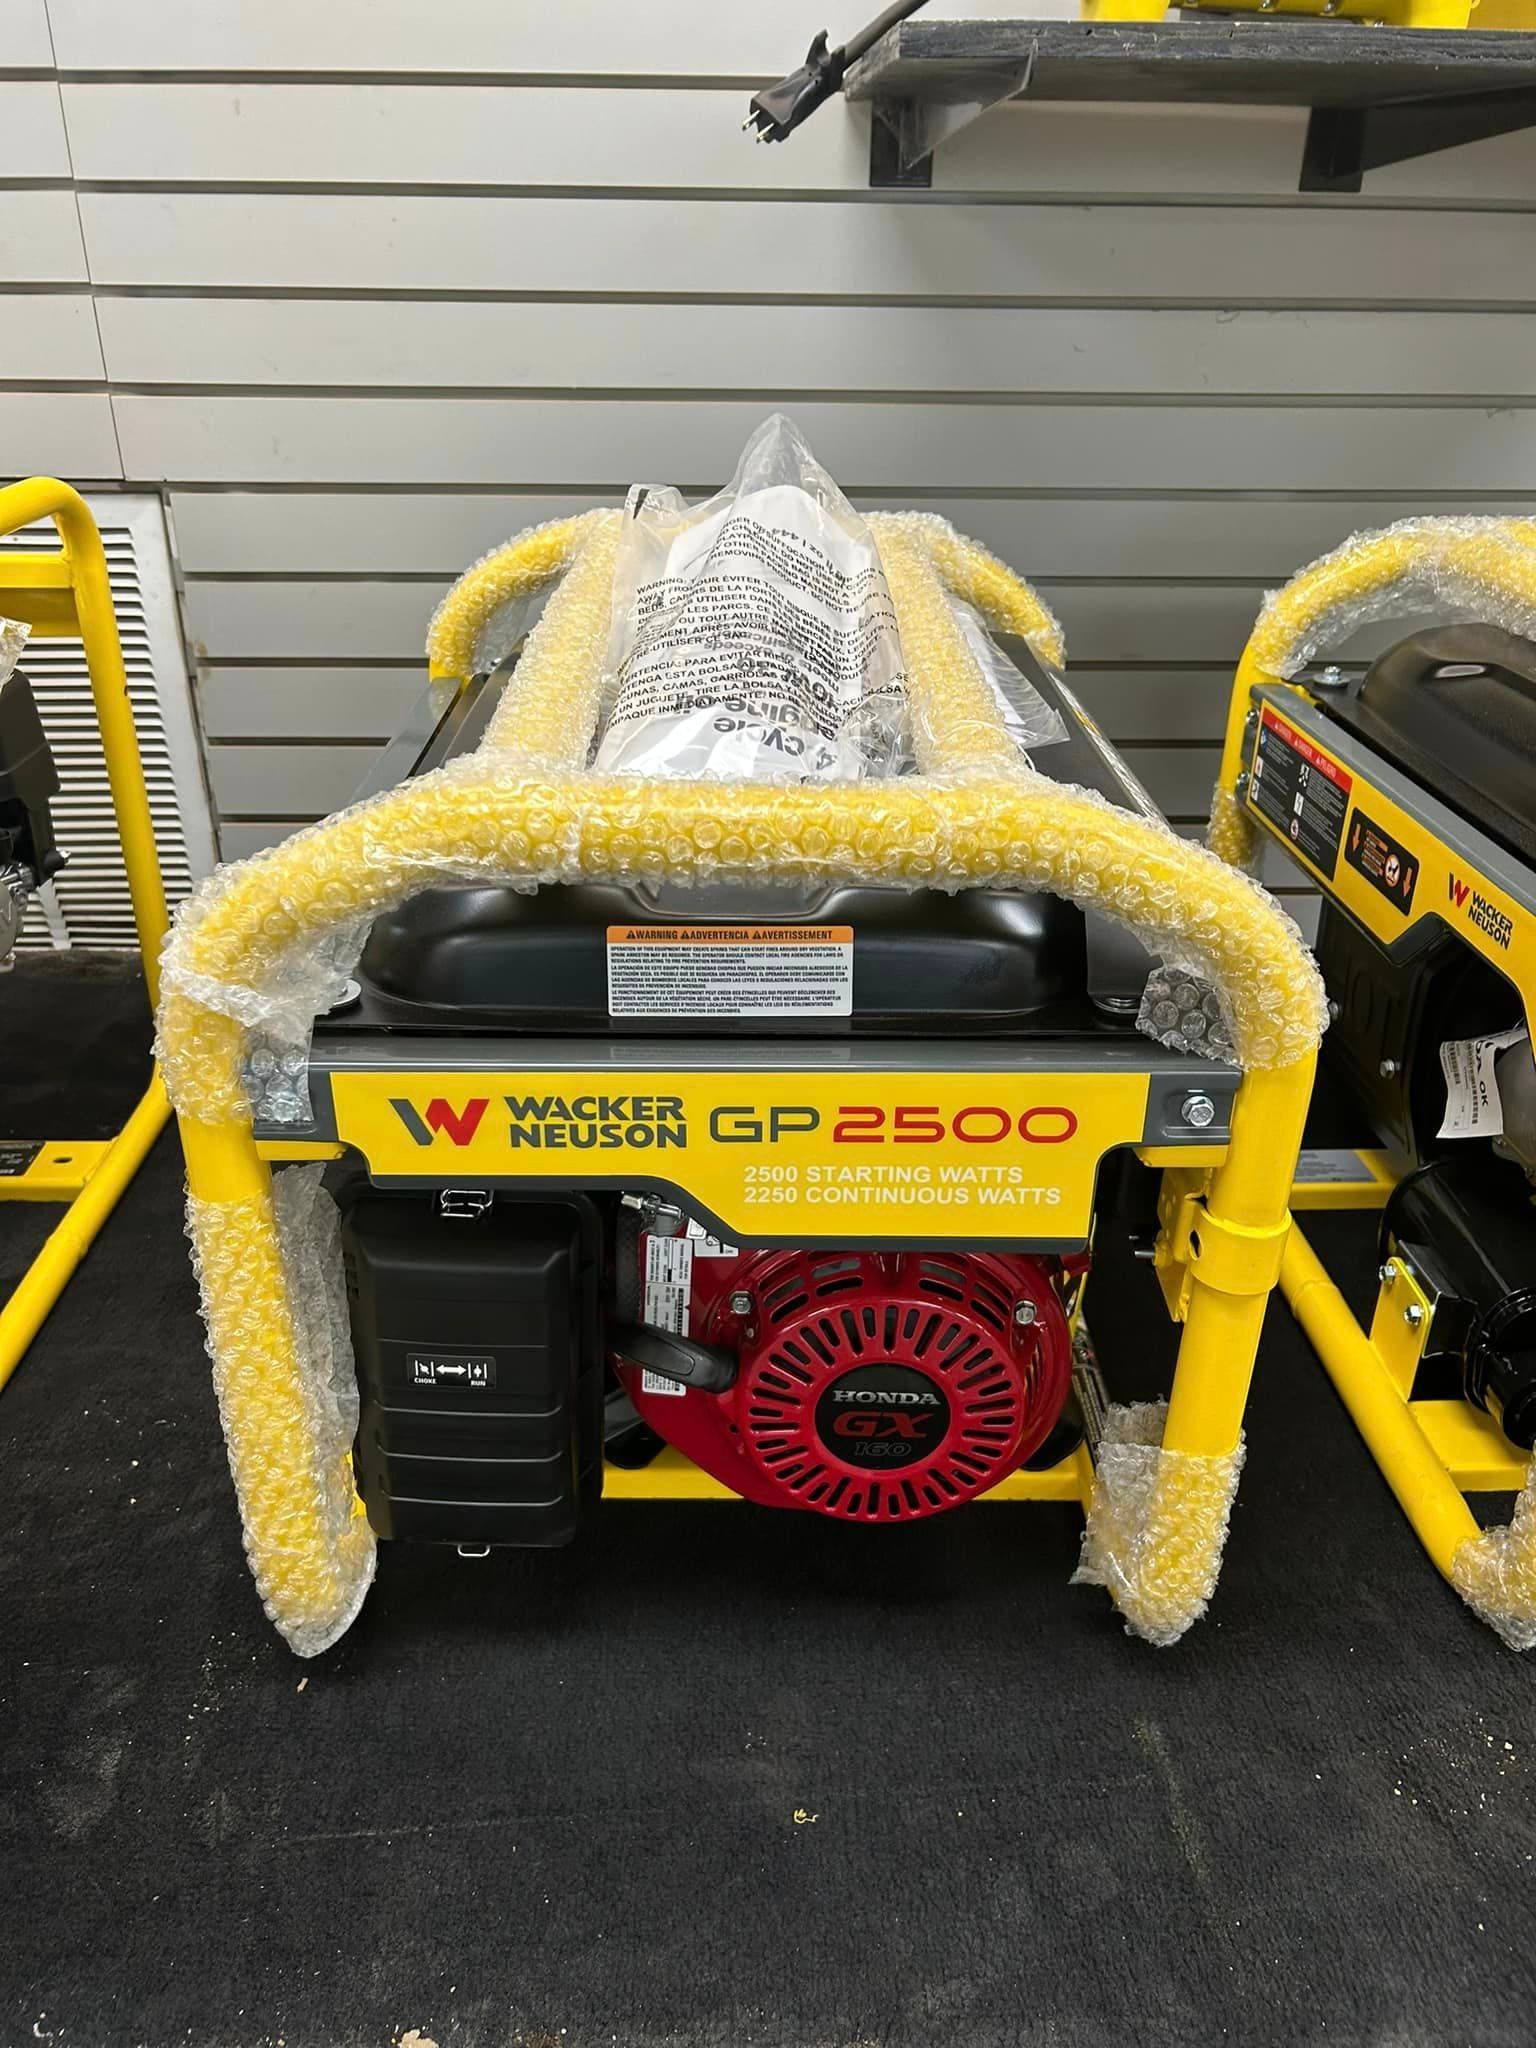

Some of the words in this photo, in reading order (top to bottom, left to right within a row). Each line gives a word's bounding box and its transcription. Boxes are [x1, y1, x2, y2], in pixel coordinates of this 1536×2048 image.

[687, 605, 709, 613] LES
[678, 616, 695, 624] OU
[699, 614, 728, 622] TOUT
[684, 656, 717, 666] PARA
[665, 670, 695, 680] ESTA
[698, 663, 738, 676] BOLSA
[696, 685, 720, 695] TIRE
[724, 683, 740, 691] LA
[742, 681, 783, 690] BOLSA
[1472, 891, 1512, 936] WACKER
[635, 930, 678, 940] WARNING
[690, 930, 750, 940] ADVERTENCIA
[762, 930, 833, 940] AVERTISSEMENT
[1468, 904, 1510, 950] NEUSON
[1478, 1080, 1489, 1106] OK
[503, 1096, 687, 1121] WACKER
[708, 1106, 821, 1144] GP
[832, 1106, 1079, 1144] 2500
[509, 1123, 688, 1148] NEUSON
[743, 1165, 798, 1184] 2500
[805, 1165, 932, 1184] STARTING
[938, 1166, 1024, 1184] WATTS
[743, 1187, 798, 1204] 2250
[805, 1186, 970, 1205] CONTINUOUS
[976, 1188, 1063, 1206] WATTS
[833, 1390, 941, 1405] HONDA
[833, 1411, 935, 1438] GX
